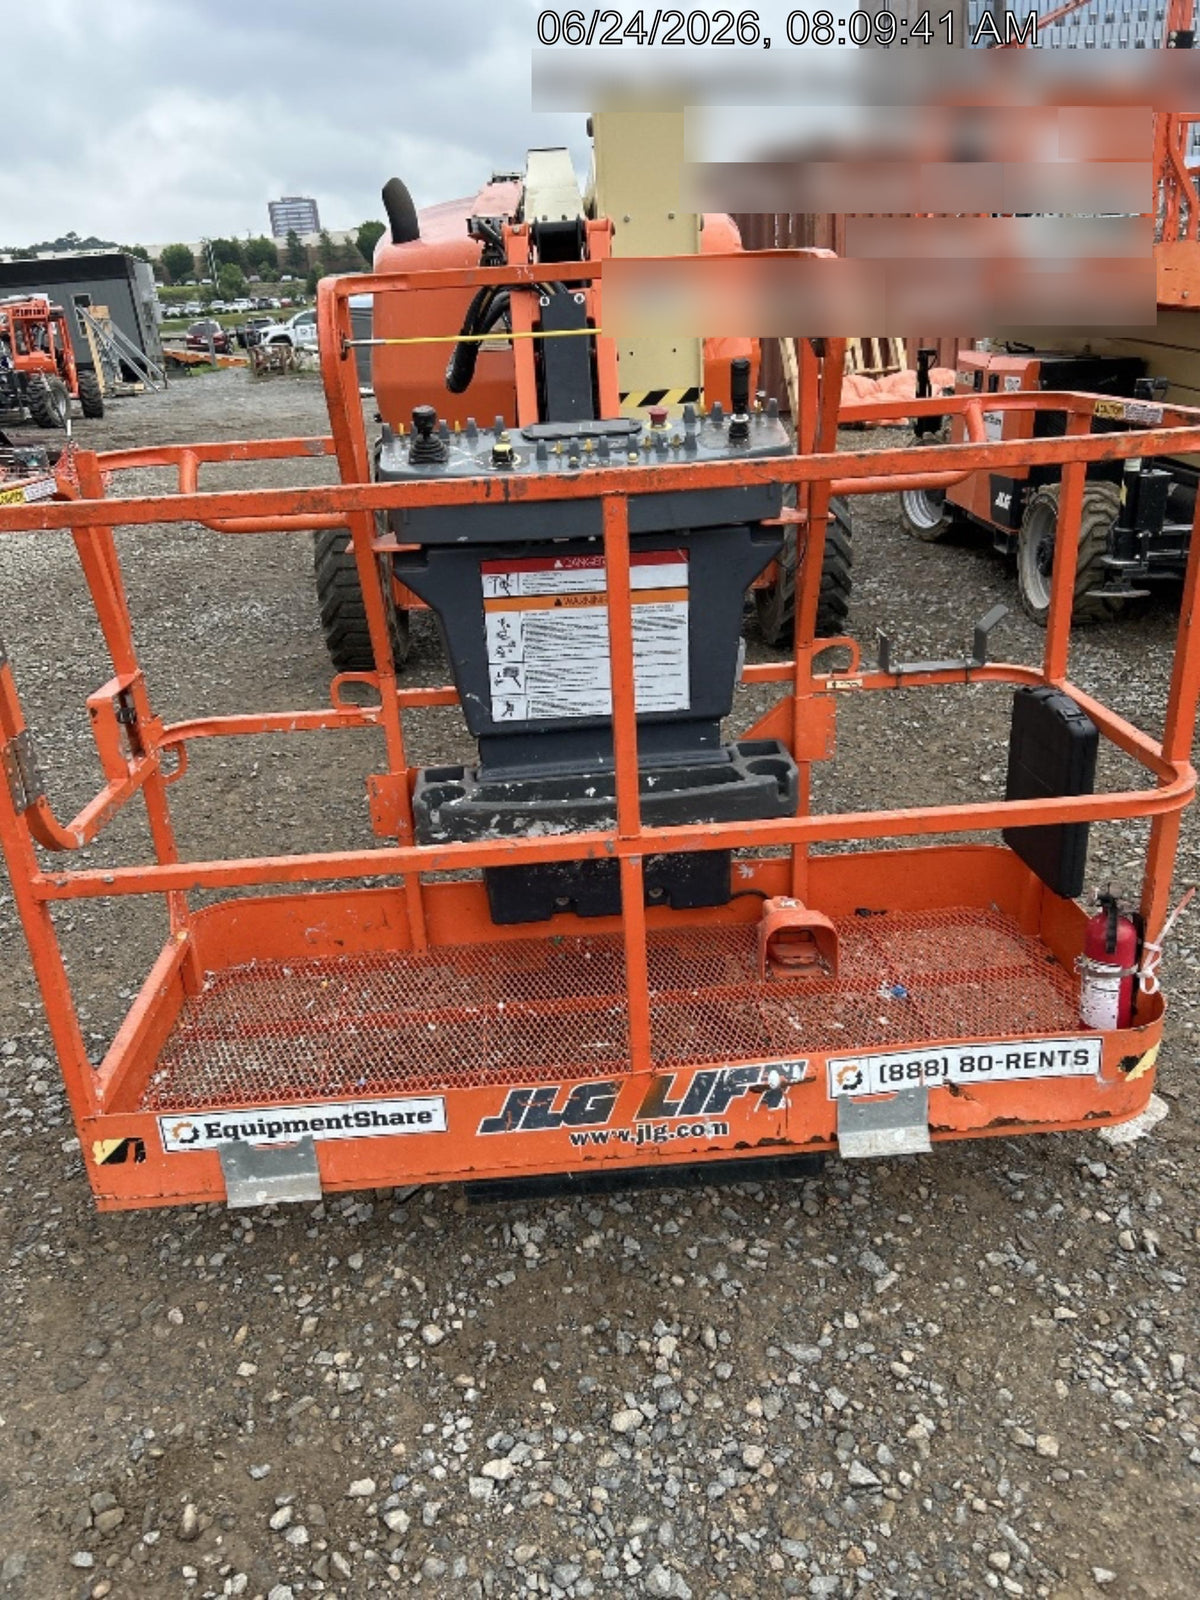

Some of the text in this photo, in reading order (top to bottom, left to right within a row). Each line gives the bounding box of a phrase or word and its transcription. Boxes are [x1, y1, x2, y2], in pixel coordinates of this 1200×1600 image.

[878, 1048, 1090, 1084] (888) 80-RENTS
[475, 1059, 809, 1136] JLG LIFT
[204, 1109, 433, 1142] EquipmentShare
[569, 1120, 730, 1147] www.jlg.com
